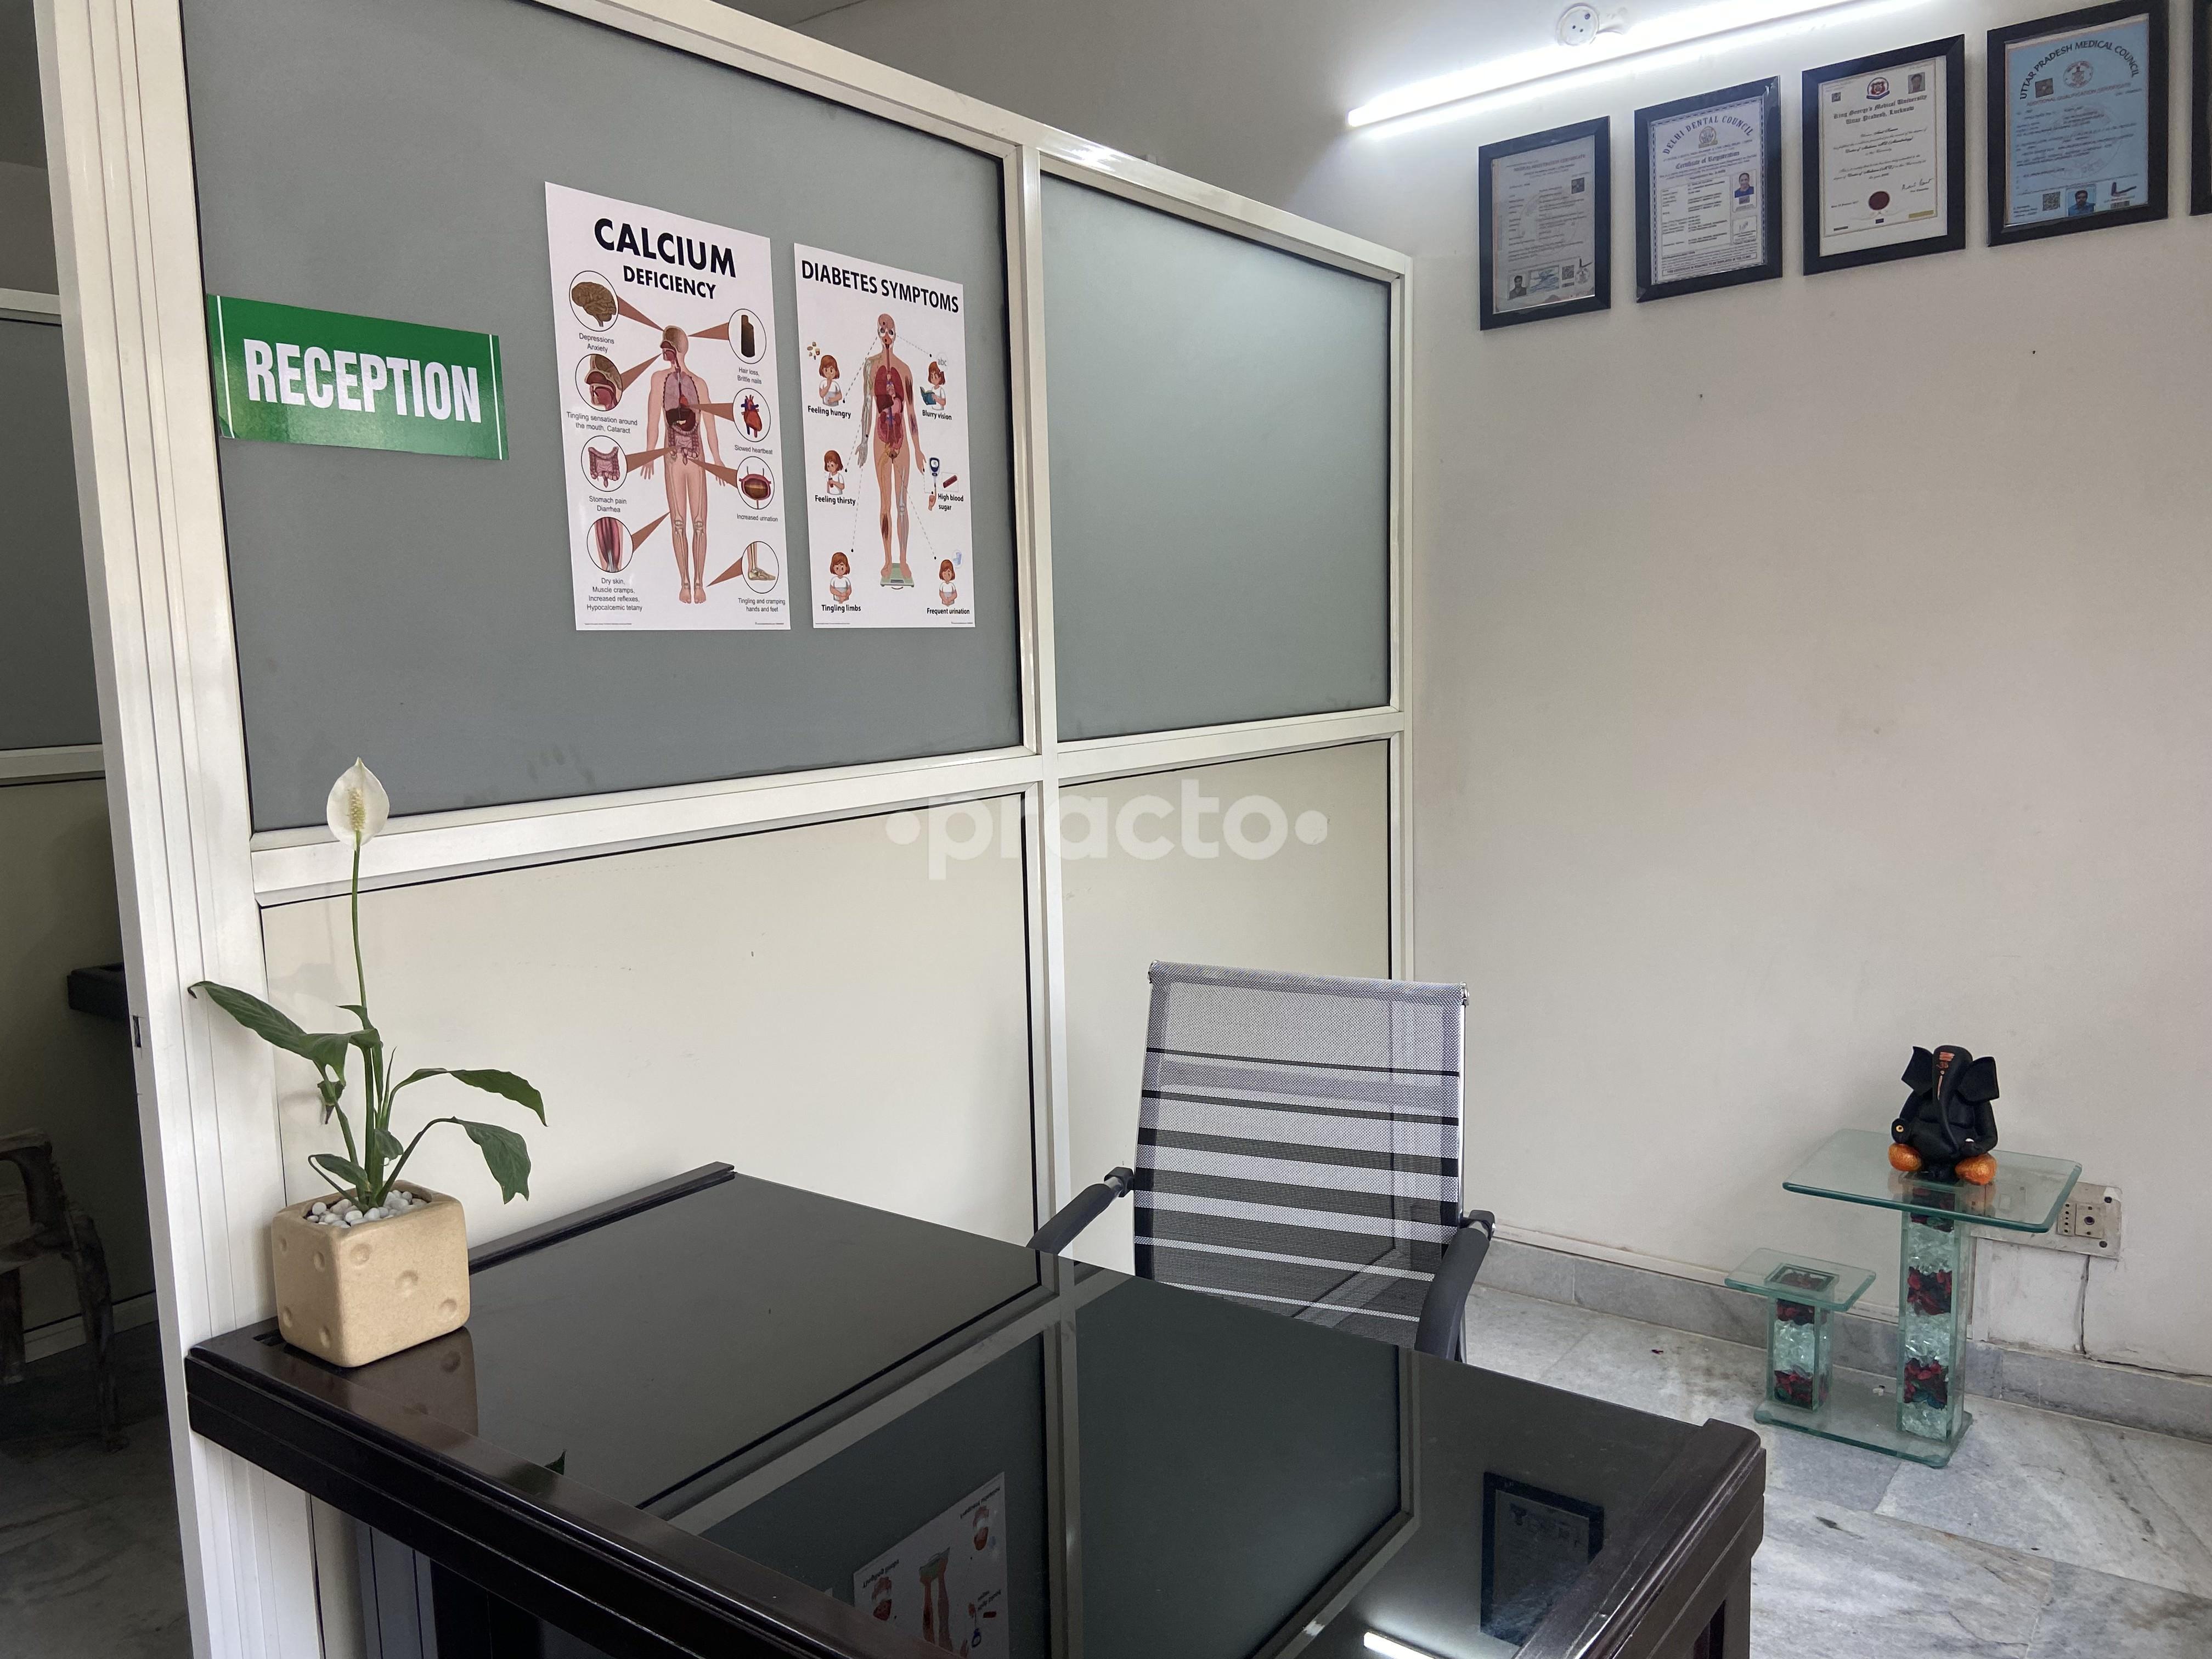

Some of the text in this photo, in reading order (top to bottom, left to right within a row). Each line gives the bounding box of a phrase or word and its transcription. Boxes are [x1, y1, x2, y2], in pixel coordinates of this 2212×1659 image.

[2020, 40, 2139, 100] UTTAR PRADESH MEDICAL COUNCIL
[1663, 130, 1685, 154] DELHI
[1685, 116, 1719, 132] DENTAL
[1722, 115, 1753, 137] COUNCIL
[594, 217, 736, 278] CALCIUM
[623, 264, 716, 300] DEFICIENCY
[801, 259, 960, 313] DIABETES SYMPTOMS
[579, 332, 615, 345] Depressions
[587, 343, 608, 354] Anxiety
[938, 357, 947, 366] abc
[243, 338, 482, 424] RECEPTION
[566, 411, 589, 421] Tingling
[590, 415, 618, 424] sensation
[807, 405, 851, 420] Feeling hungry
[922, 409, 952, 420] Blurry vision
[607, 425, 631, 434] Cataract
[815, 495, 856, 506] Feeling thirsty
[938, 493, 964, 502] High blood
[596, 505, 621, 513] Diarrhea
[601, 577, 611, 585] Dry
[586, 603, 625, 612] Hypocalcemic
[821, 604, 845, 613] Tingling
[927, 607, 949, 616] Frequent
